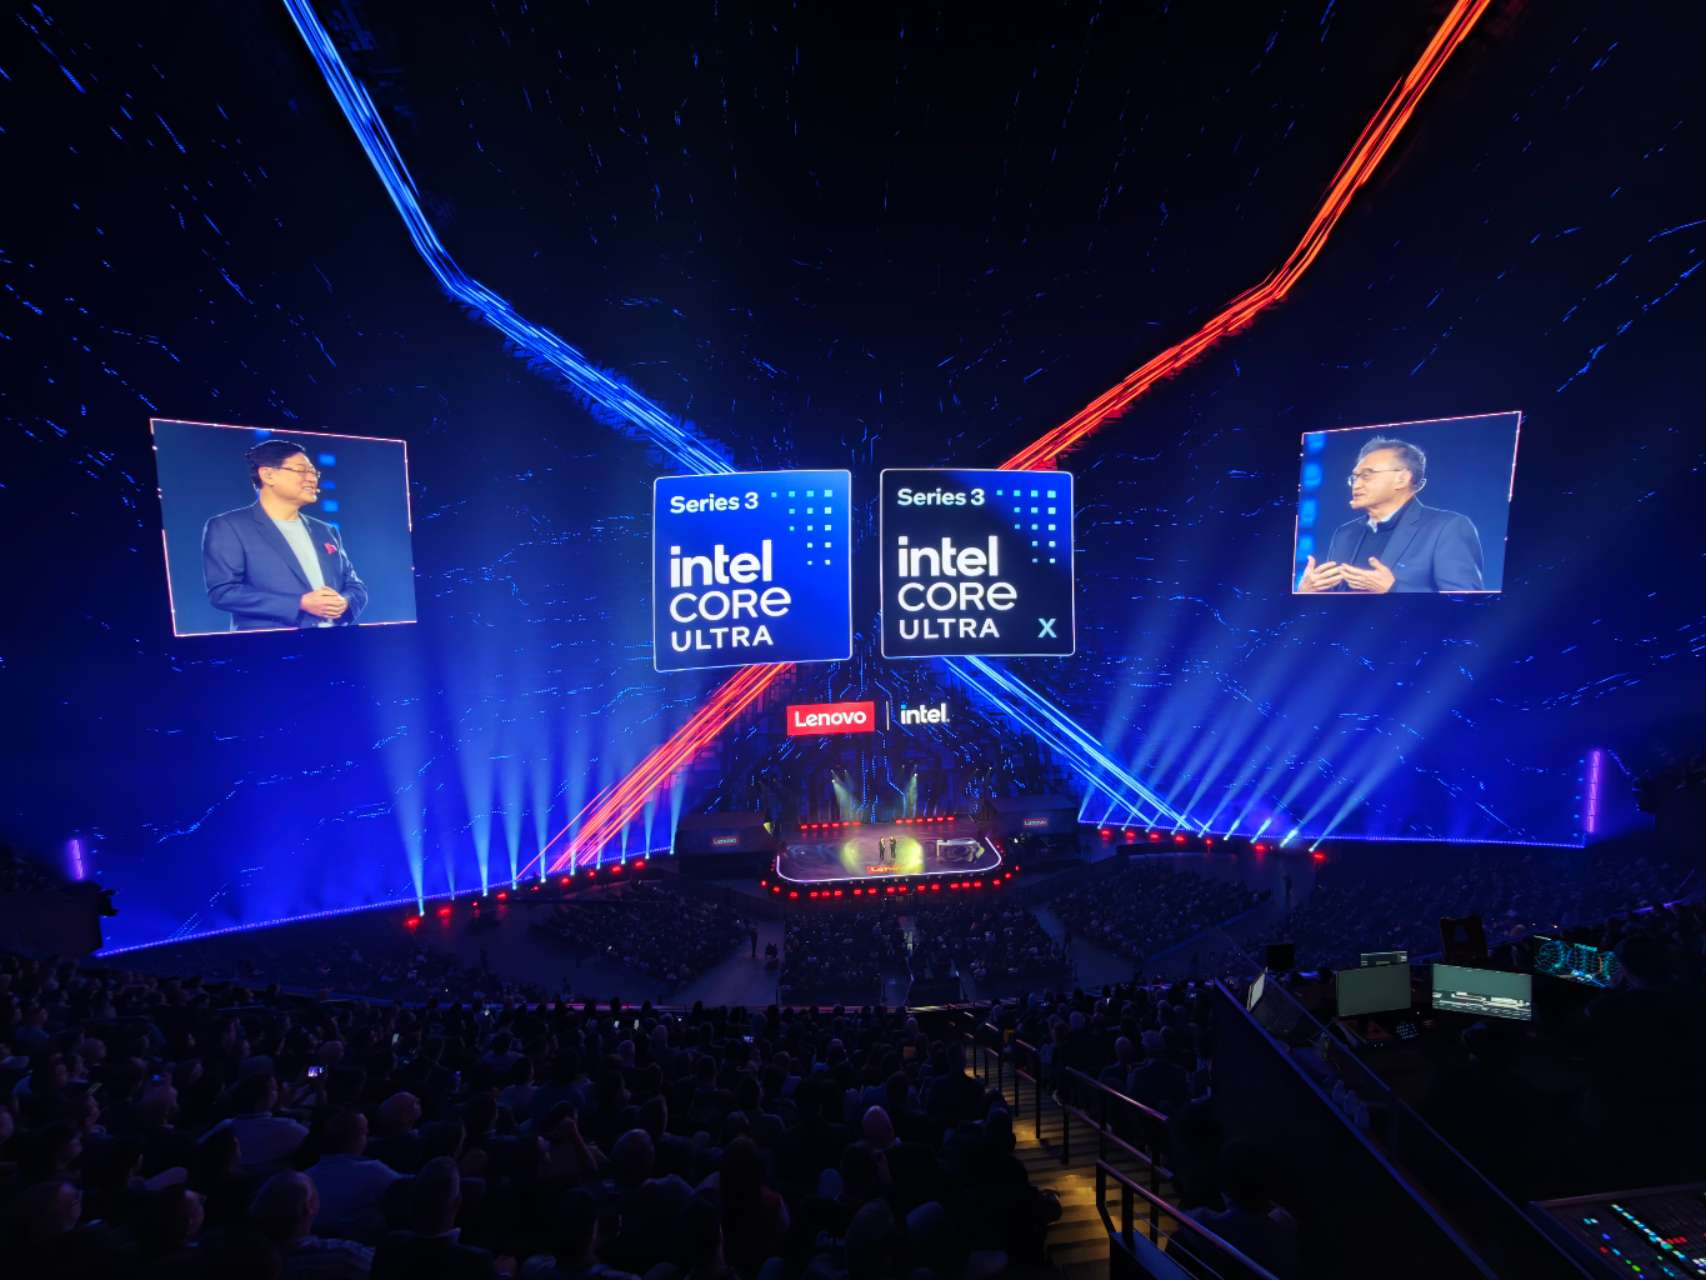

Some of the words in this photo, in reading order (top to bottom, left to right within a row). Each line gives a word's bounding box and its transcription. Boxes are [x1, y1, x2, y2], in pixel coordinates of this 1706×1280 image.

[670, 493, 740, 514] Series
[744, 491, 759, 510] 3
[897, 487, 967, 506] Series
[970, 487, 985, 506] 3
[670, 539, 773, 588] intel
[898, 535, 999, 577] intel
[671, 625, 774, 652] ULTRA
[899, 618, 1000, 639] ULTRA
[1037, 617, 1057, 639] X
[794, 710, 867, 728] Lenovo
